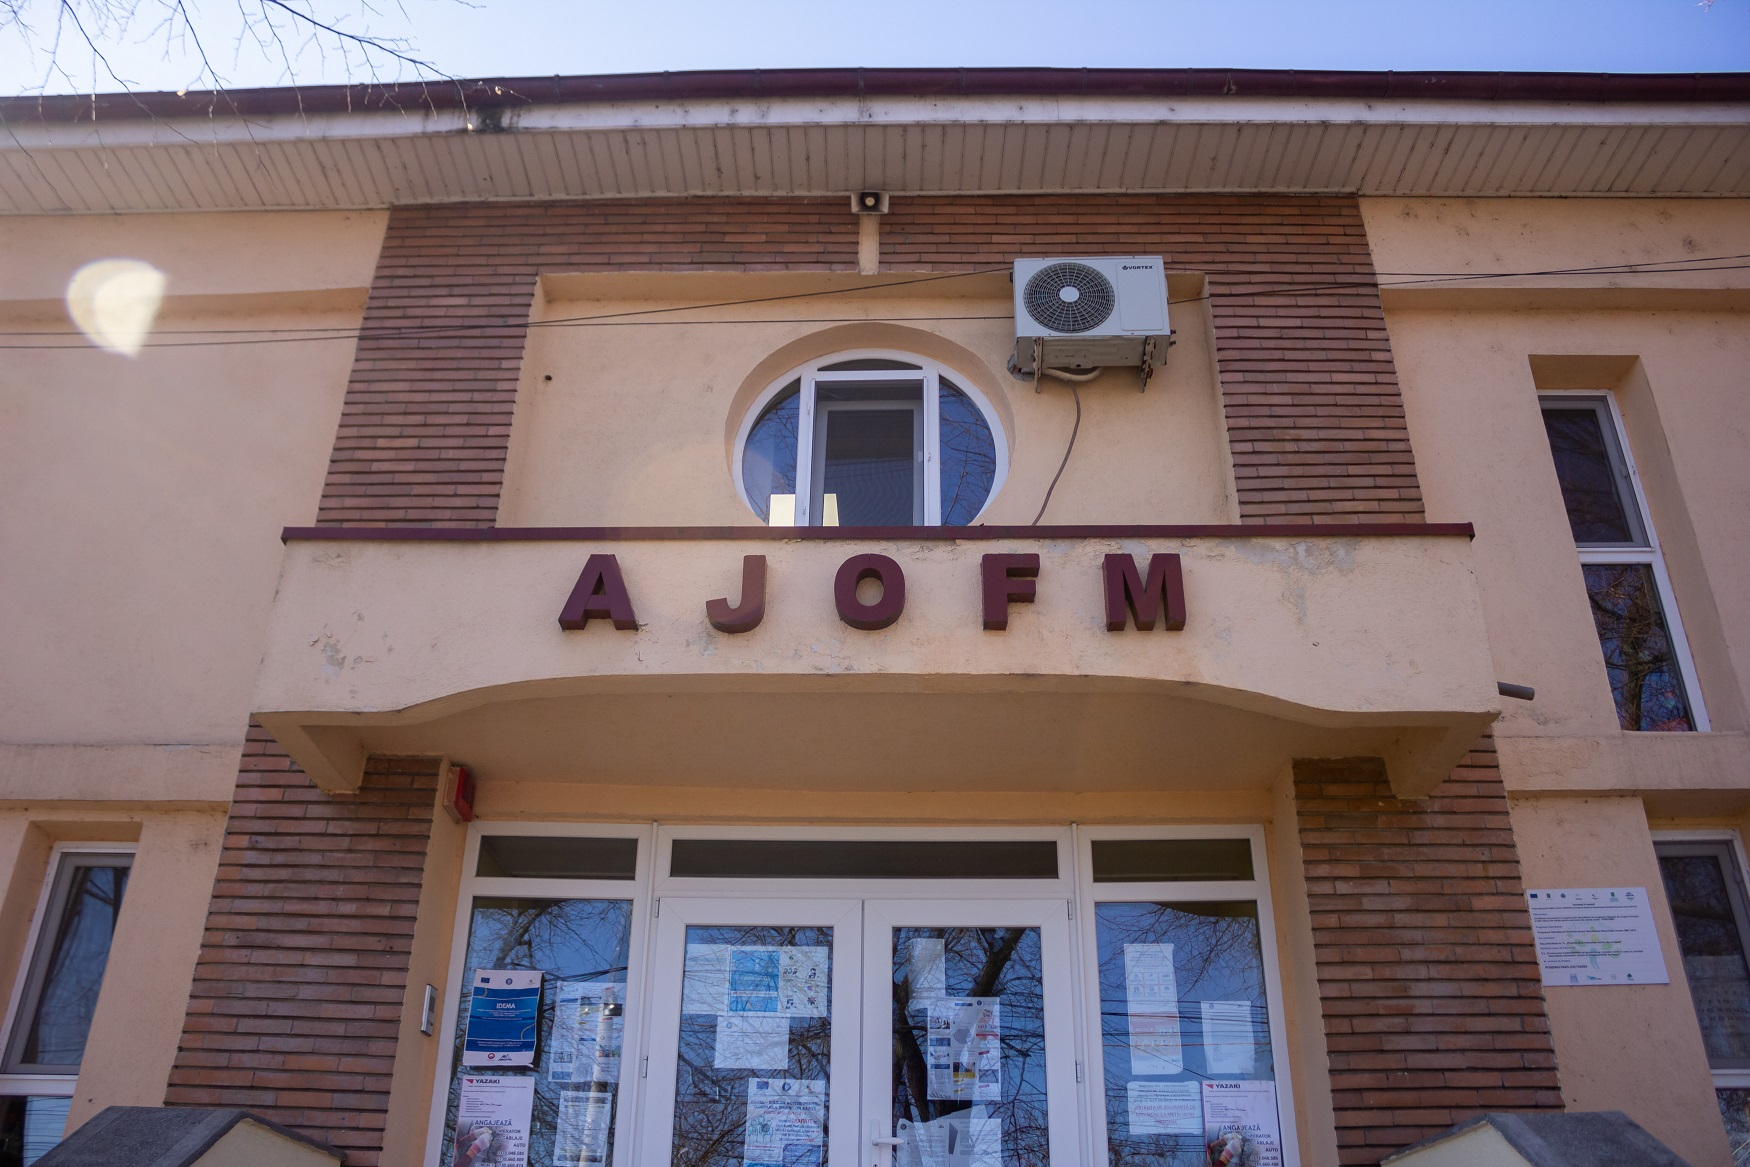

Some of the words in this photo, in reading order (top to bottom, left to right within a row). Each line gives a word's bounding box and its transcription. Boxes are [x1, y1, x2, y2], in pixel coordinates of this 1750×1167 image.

[557, 553, 1188, 634] AJOFM
[474, 1118, 513, 1126] ANGAJEAZĂ
[1222, 1123, 1262, 1131] ANGAJEAZĂ
